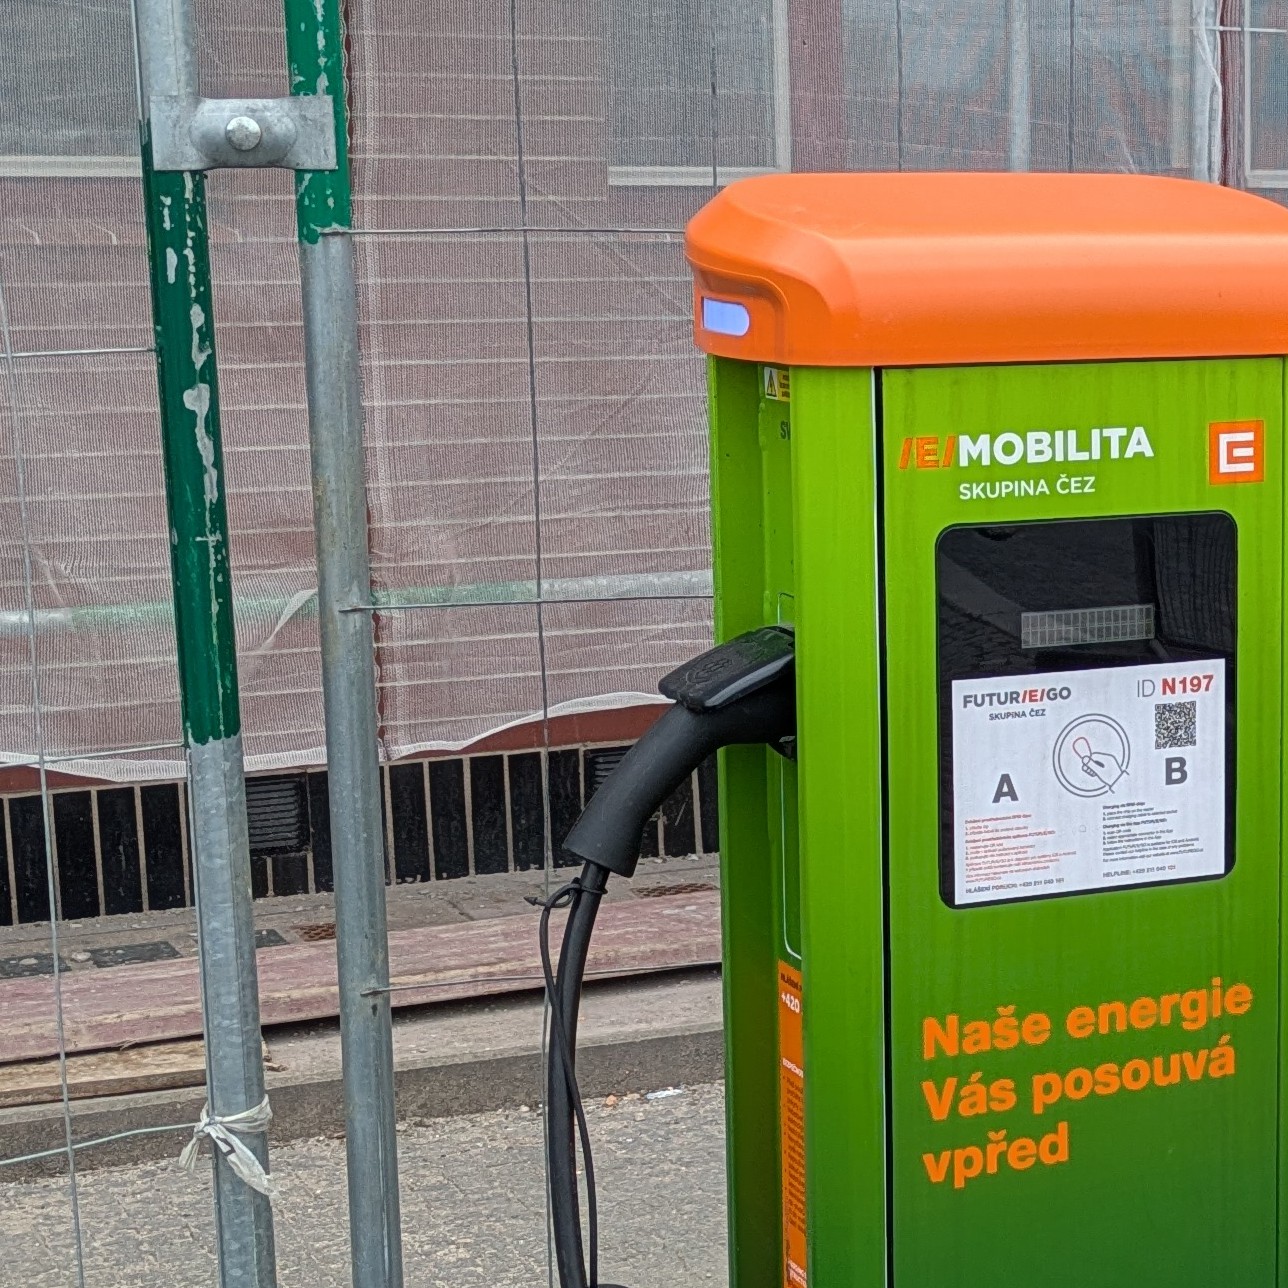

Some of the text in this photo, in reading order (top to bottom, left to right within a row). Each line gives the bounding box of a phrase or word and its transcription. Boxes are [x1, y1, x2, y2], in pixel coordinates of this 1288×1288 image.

[959, 474, 1096, 500] SKUPINA ČEZ
[963, 686, 1072, 708] FUTUR/E/GO
[1137, 675, 1215, 698] ID N197
[989, 708, 1046, 721] SKUPINA ČEZ
[1165, 756, 1188, 785] B
[992, 773, 1019, 803] A
[922, 976, 1253, 1061] Naše energie
[921, 1033, 1236, 1122] Vás posouvá
[922, 1121, 1069, 1189] vpřed
